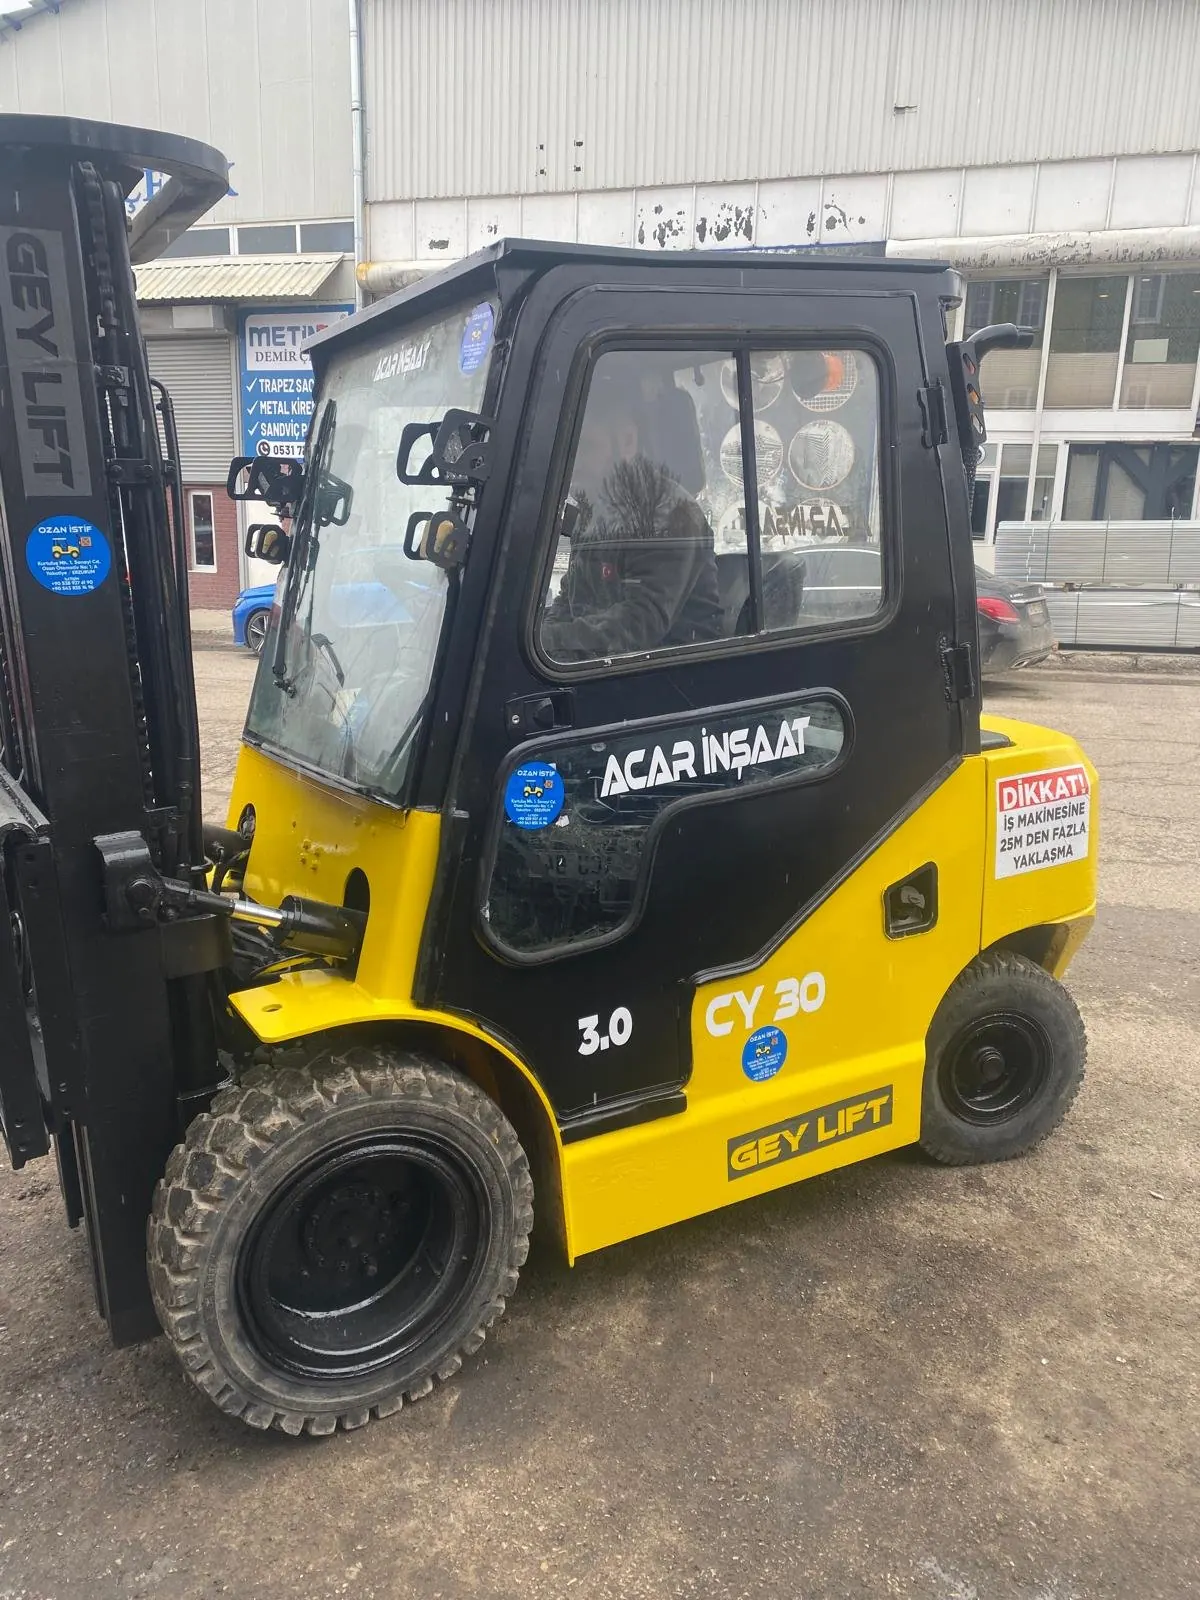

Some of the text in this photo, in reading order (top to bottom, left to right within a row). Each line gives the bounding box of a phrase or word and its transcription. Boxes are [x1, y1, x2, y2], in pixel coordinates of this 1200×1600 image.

[7, 232, 75, 489] GEY LIFT
[255, 349, 312, 364] DEMİR Ç
[373, 353, 399, 382] ACAR
[259, 379, 294, 393] TRAPEZ
[260, 397, 315, 415] METAL KİRE
[260, 419, 300, 440] SANDVİÇ
[273, 445, 295, 456] 0531
[38, 526, 67, 534] OZAN
[600, 716, 811, 798] ACAR İNŞAAT
[1002, 774, 1086, 810] DİKKAT!
[1004, 802, 1086, 832] İŞ MAKİNESİNE
[1000, 821, 1086, 852] 25M DEN FAZLA
[1013, 844, 1073, 869] YAKLAŞMA
[705, 971, 826, 1037] CY 30
[578, 1006, 633, 1056] 3.0
[730, 1095, 890, 1171] GEY LIFT
